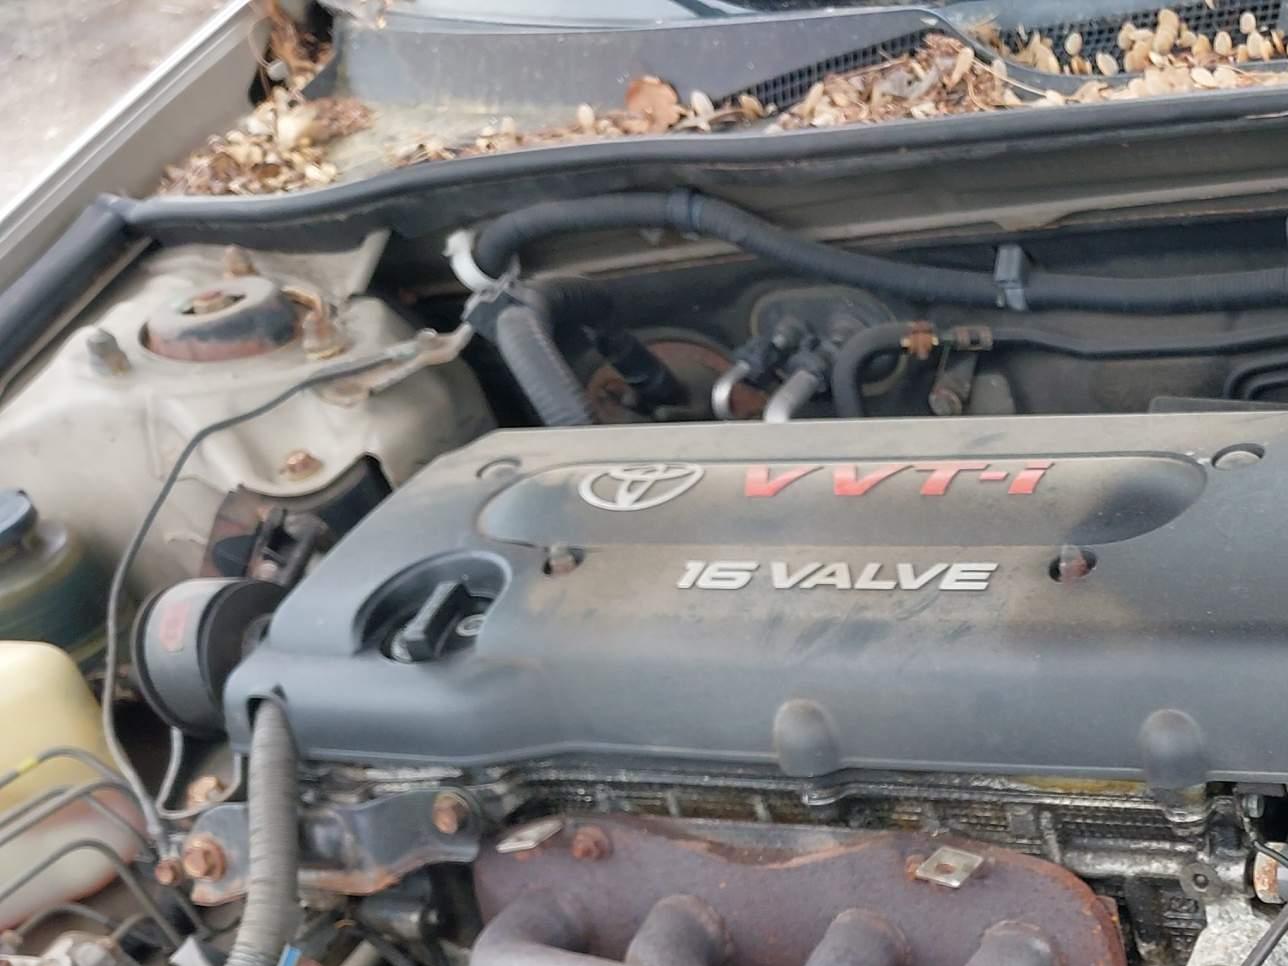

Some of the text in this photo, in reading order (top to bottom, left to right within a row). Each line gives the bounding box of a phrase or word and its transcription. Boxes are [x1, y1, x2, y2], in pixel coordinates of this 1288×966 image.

[744, 461, 1056, 497] VVT-i
[676, 560, 999, 591] 16 VALVE
